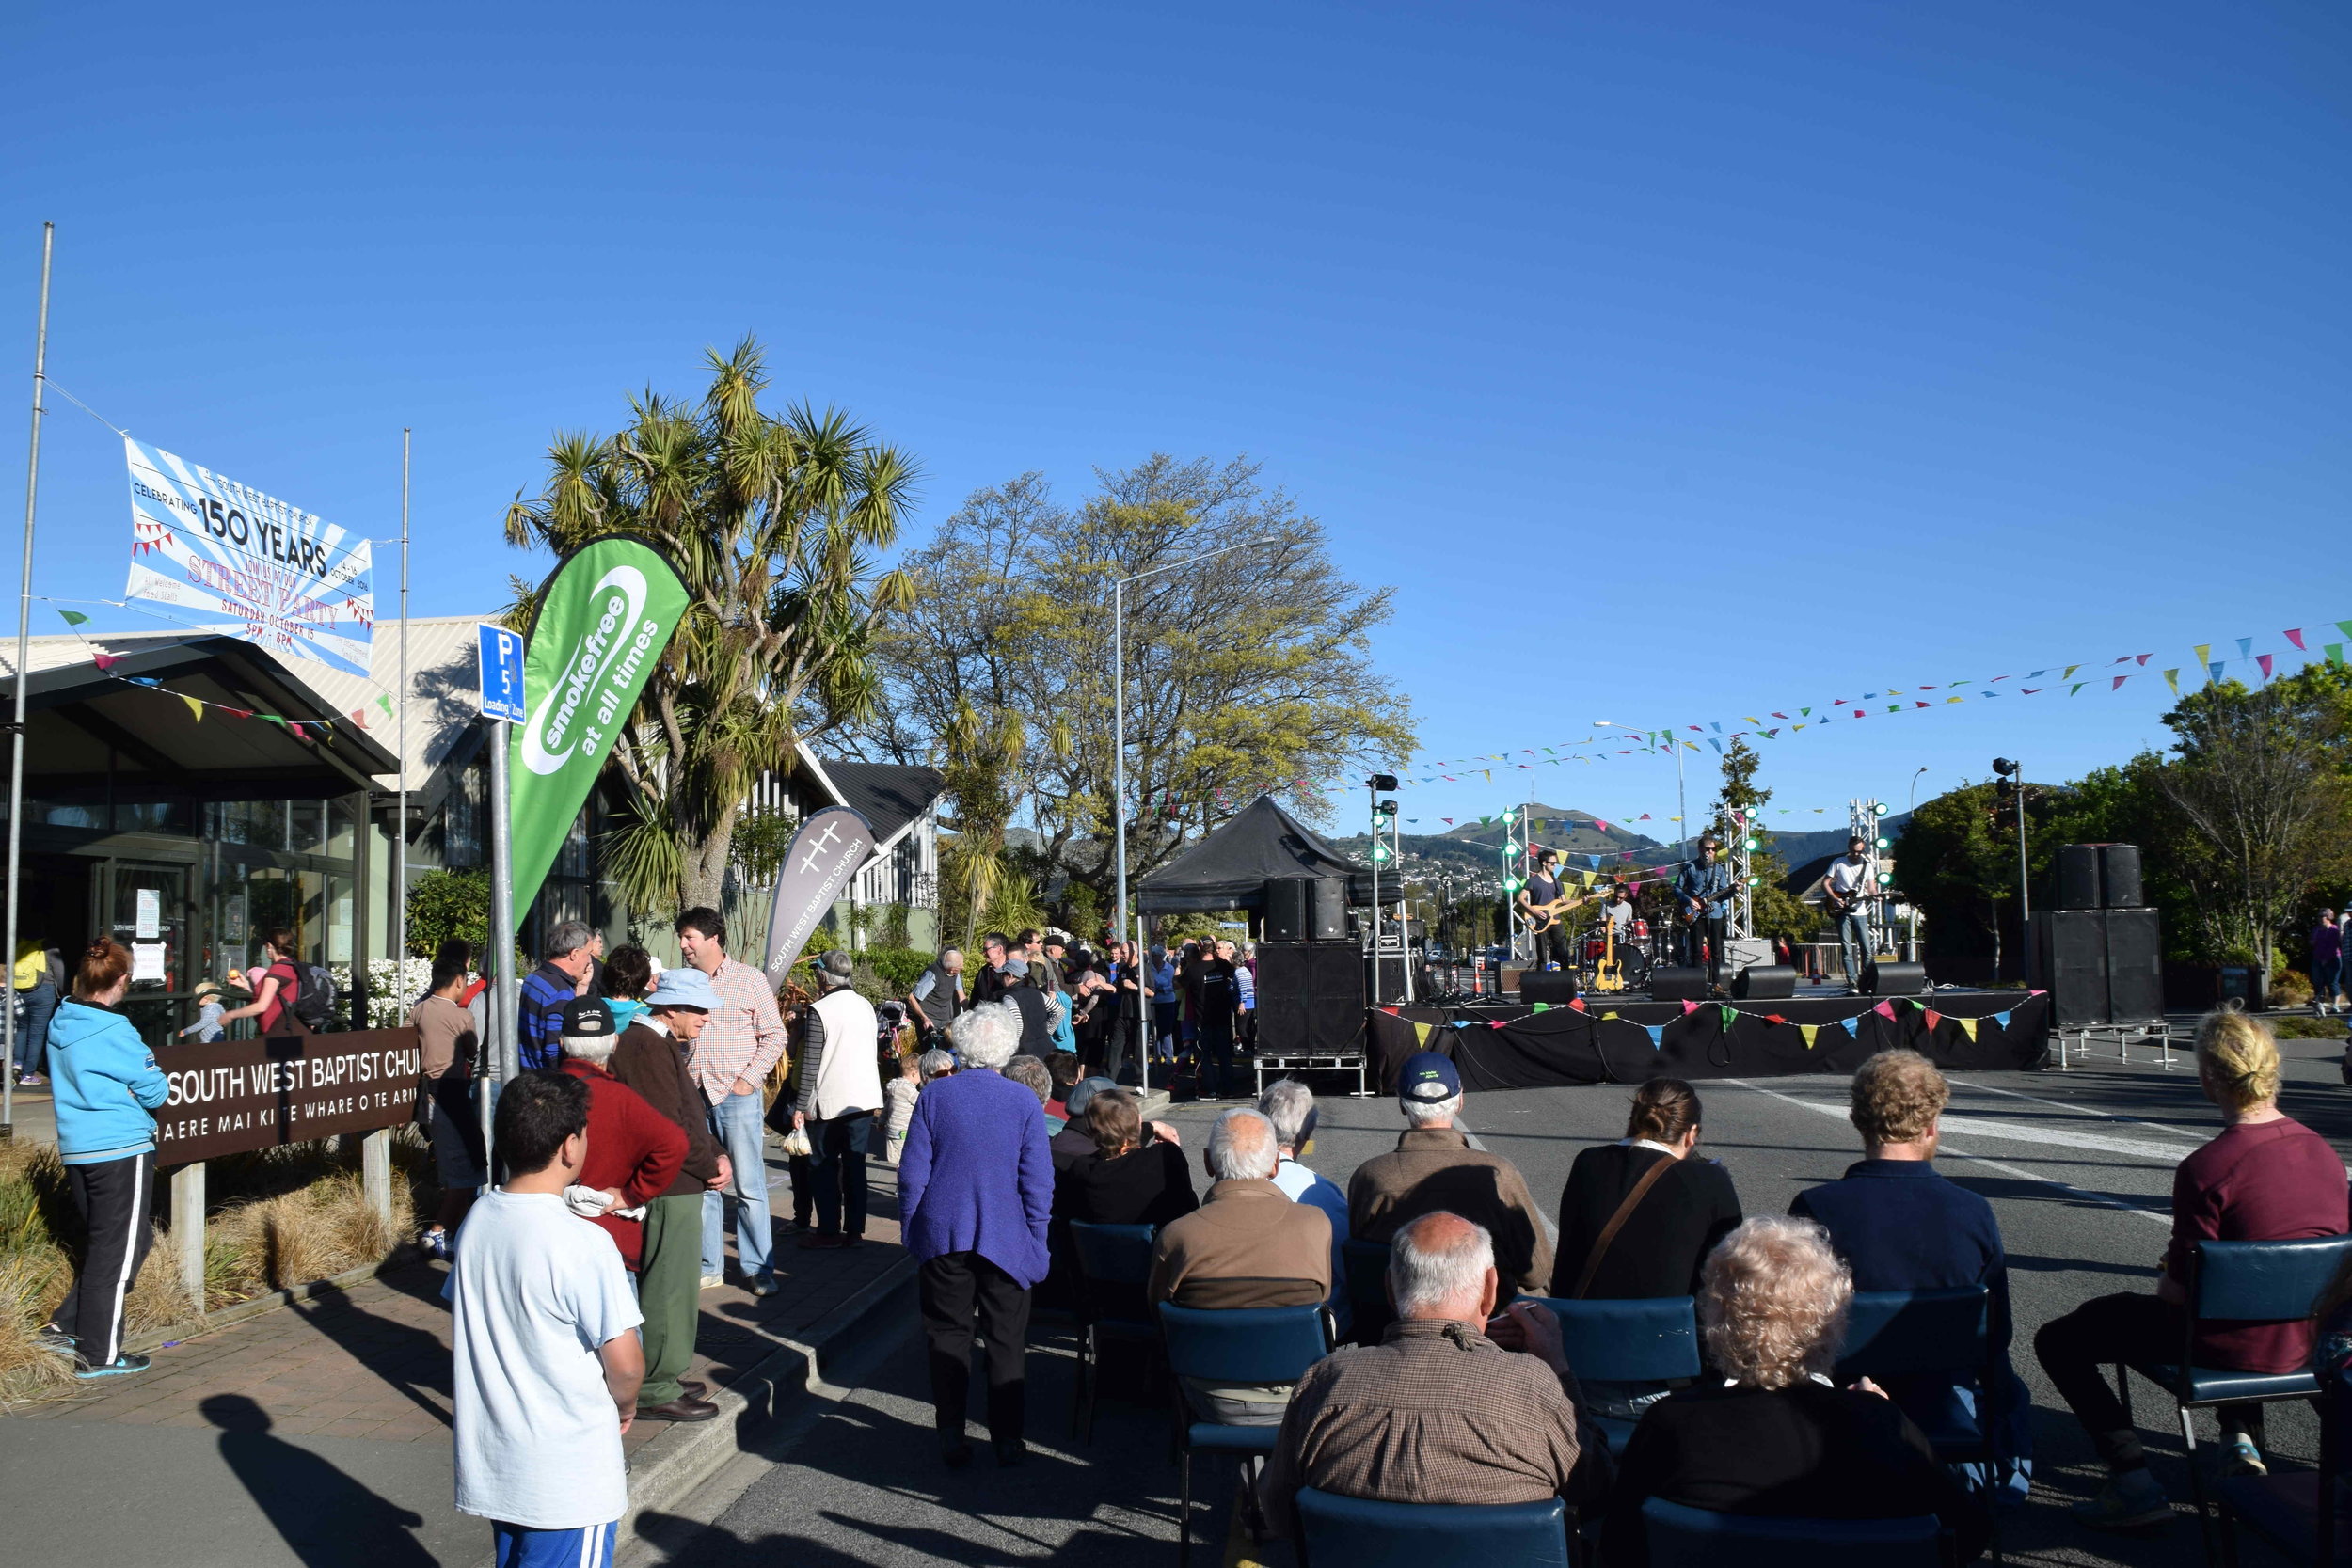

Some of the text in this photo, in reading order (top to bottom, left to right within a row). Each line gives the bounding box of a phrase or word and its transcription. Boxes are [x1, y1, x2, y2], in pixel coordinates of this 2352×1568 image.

[134, 483, 198, 515] CELEBRATING
[217, 478, 313, 527] SOUTH WEST BAPTIST CHURCH
[199, 498, 327, 578] 150 YEARS
[188, 555, 339, 631] STREET PARTY
[245, 559, 297, 589] JOIN US AT OUR
[330, 567, 369, 592] OCTOBER 2016
[221, 599, 314, 641] SATURDAY OCTOBER 15
[246, 623, 263, 639] 5PM
[276, 632, 292, 648] 8PM
[498, 633, 513, 665] P
[501, 670, 510, 694] 5
[547, 595, 625, 749] smokefree
[581, 619, 659, 756] at all times
[485, 696, 524, 718] Loading Zone
[771, 938, 794, 972] SOUTH
[790, 912, 810, 939] WEST
[807, 875, 835, 912] BAPTIST
[833, 838, 863, 876] CHURCH
[167, 1067, 245, 1106] SOUTH
[251, 1060, 306, 1095] WEST
[312, 1053, 380, 1087] BAPTIST
[218, 1112, 251, 1133] MAI
[260, 1108, 275, 1127] KI
[282, 1105, 297, 1122] TE
[304, 1097, 353, 1119] WHARE
[359, 1094, 369, 1111] O
[374, 1092, 387, 1108] TE
